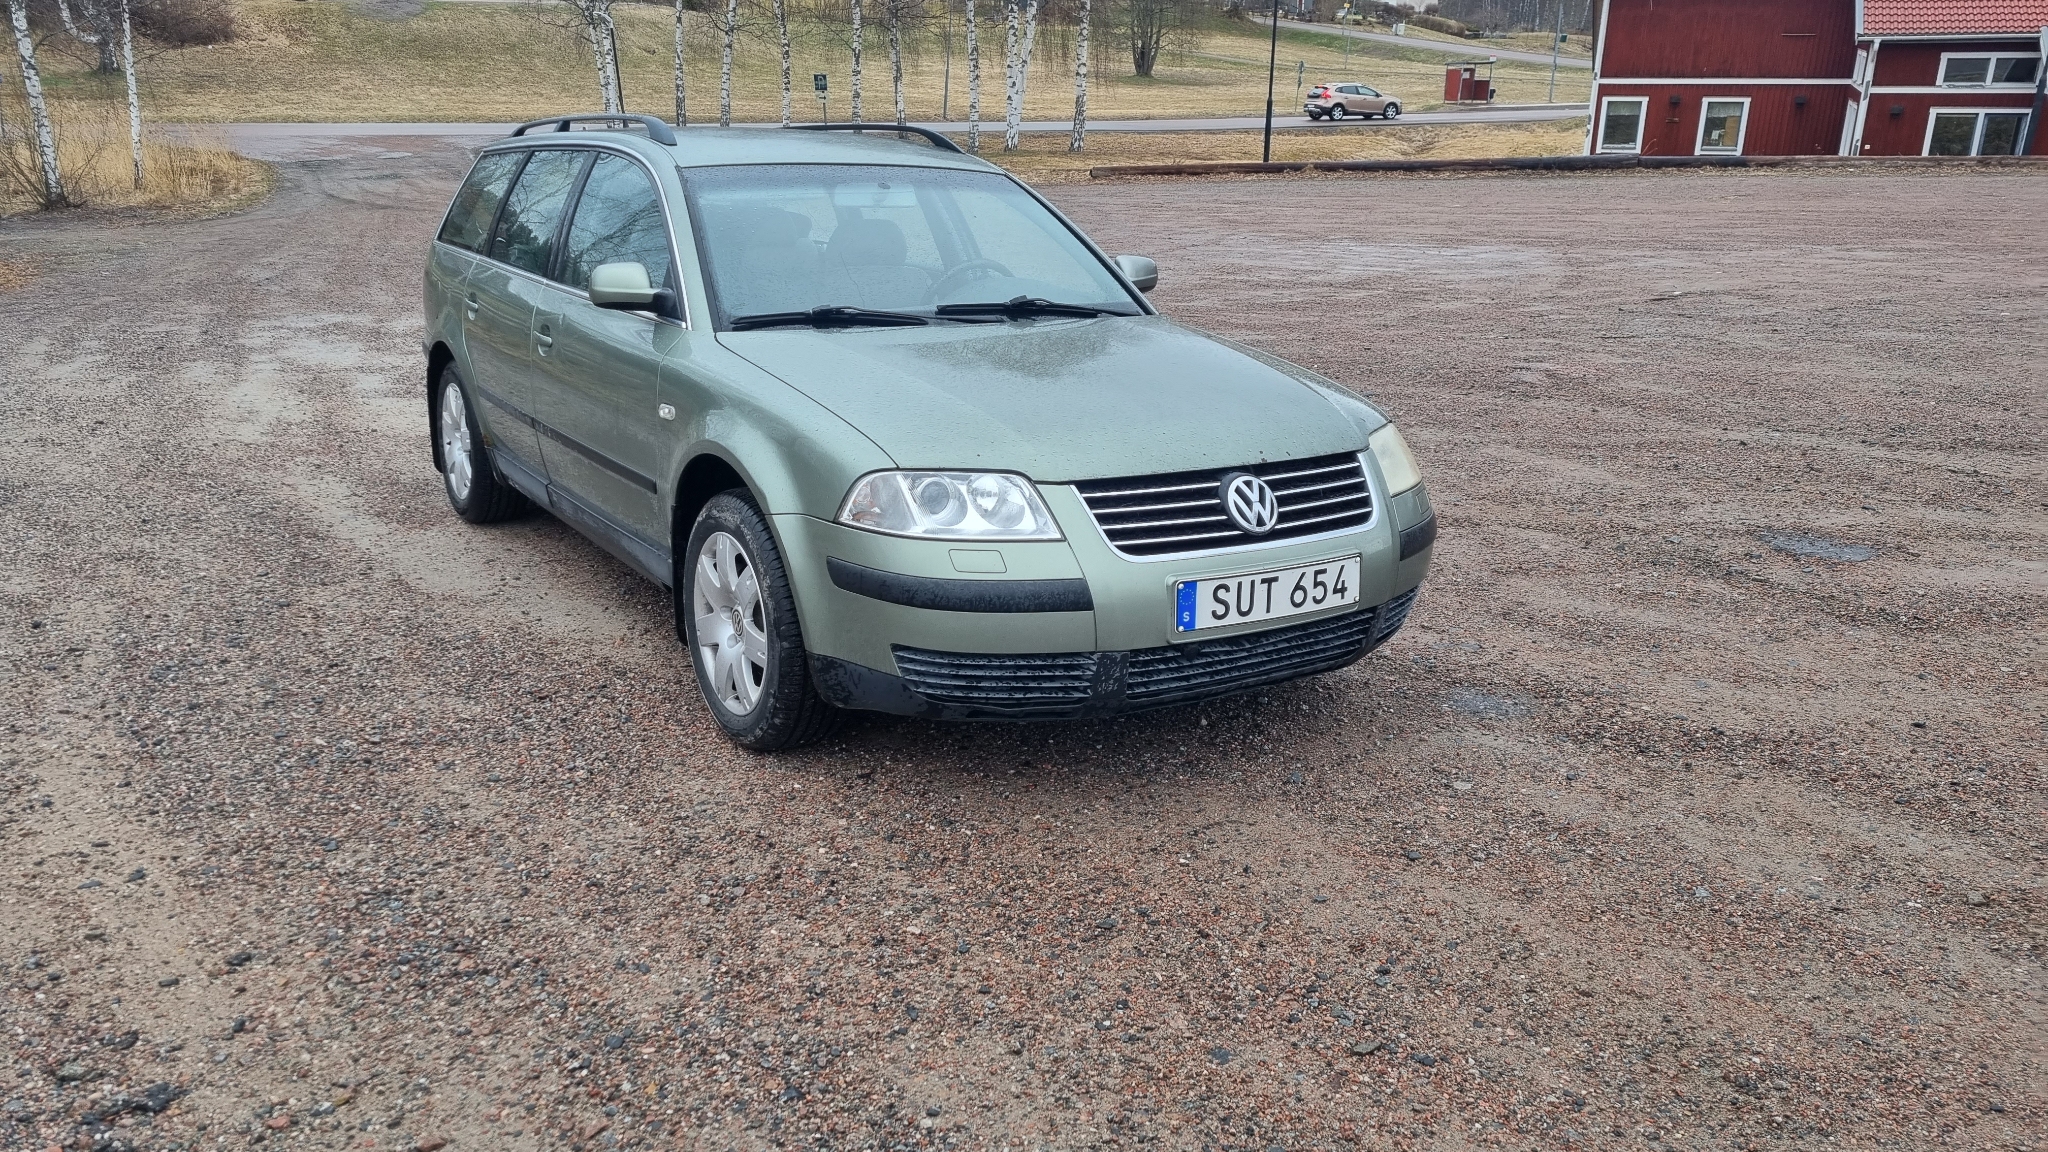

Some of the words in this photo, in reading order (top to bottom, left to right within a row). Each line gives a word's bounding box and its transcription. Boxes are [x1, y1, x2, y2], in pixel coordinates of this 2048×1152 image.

[817, 75, 825, 89] P
[1228, 476, 1278, 532] VW
[1211, 576, 1280, 621] SUT
[1290, 564, 1348, 609] 654
[1183, 611, 1190, 622] S
